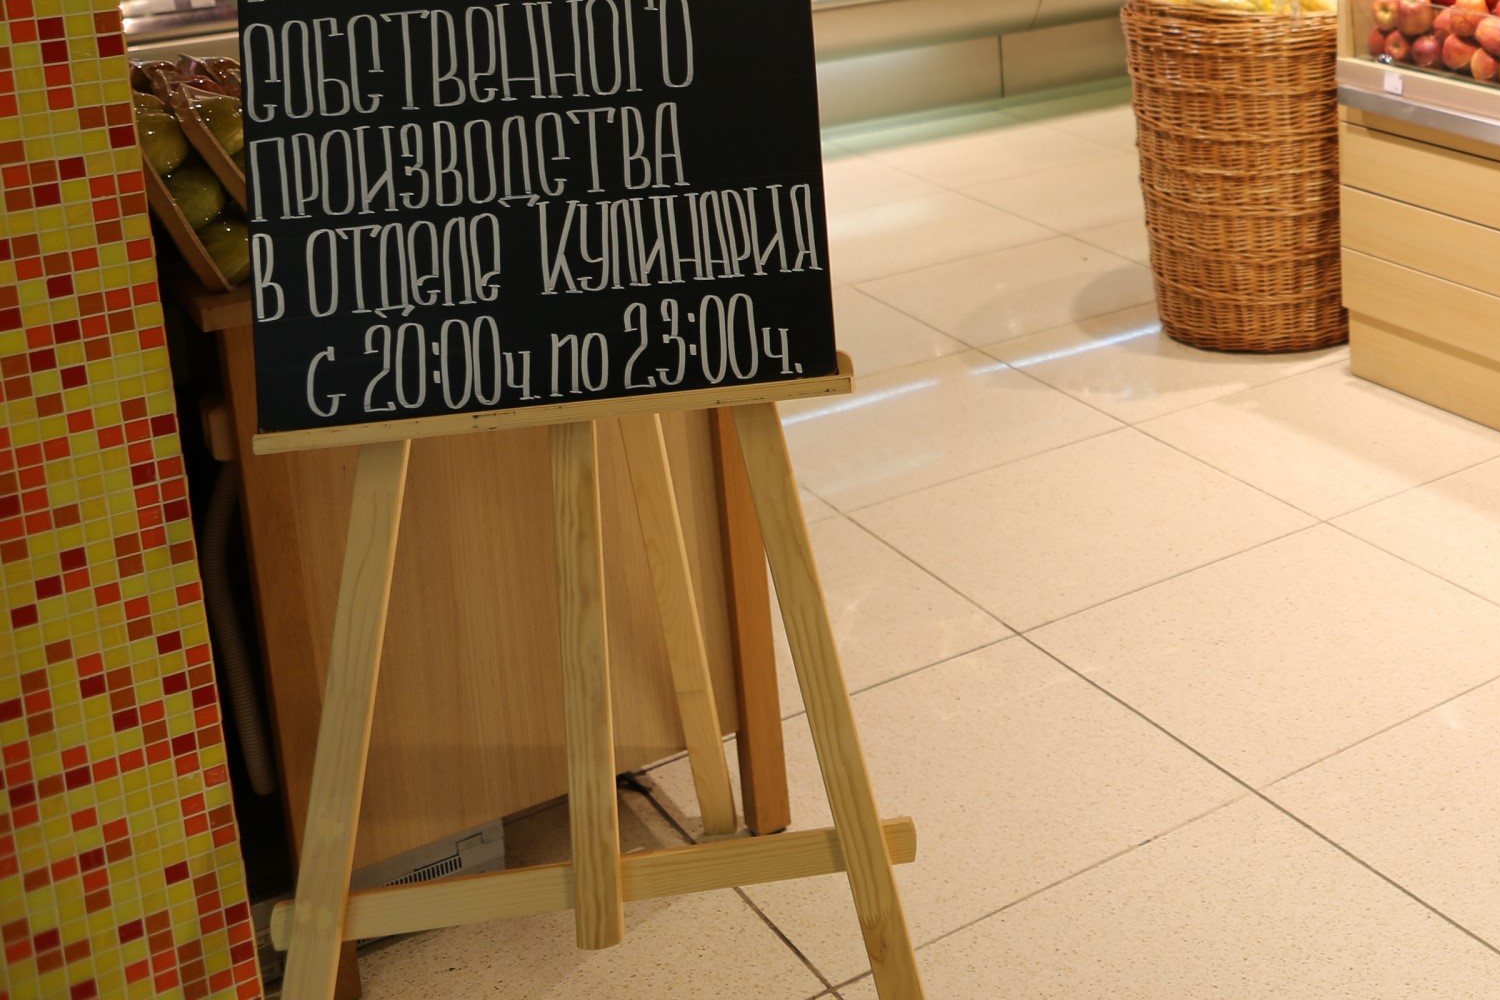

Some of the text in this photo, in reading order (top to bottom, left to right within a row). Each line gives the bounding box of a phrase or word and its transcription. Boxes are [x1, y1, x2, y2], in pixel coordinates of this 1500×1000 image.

[248, 101, 691, 223] ПРОИЗВОДСТВА
[251, 183, 825, 323] В ОТДЕЛЕ КУЛИНАРИЯ
[549, 331, 610, 399] по
